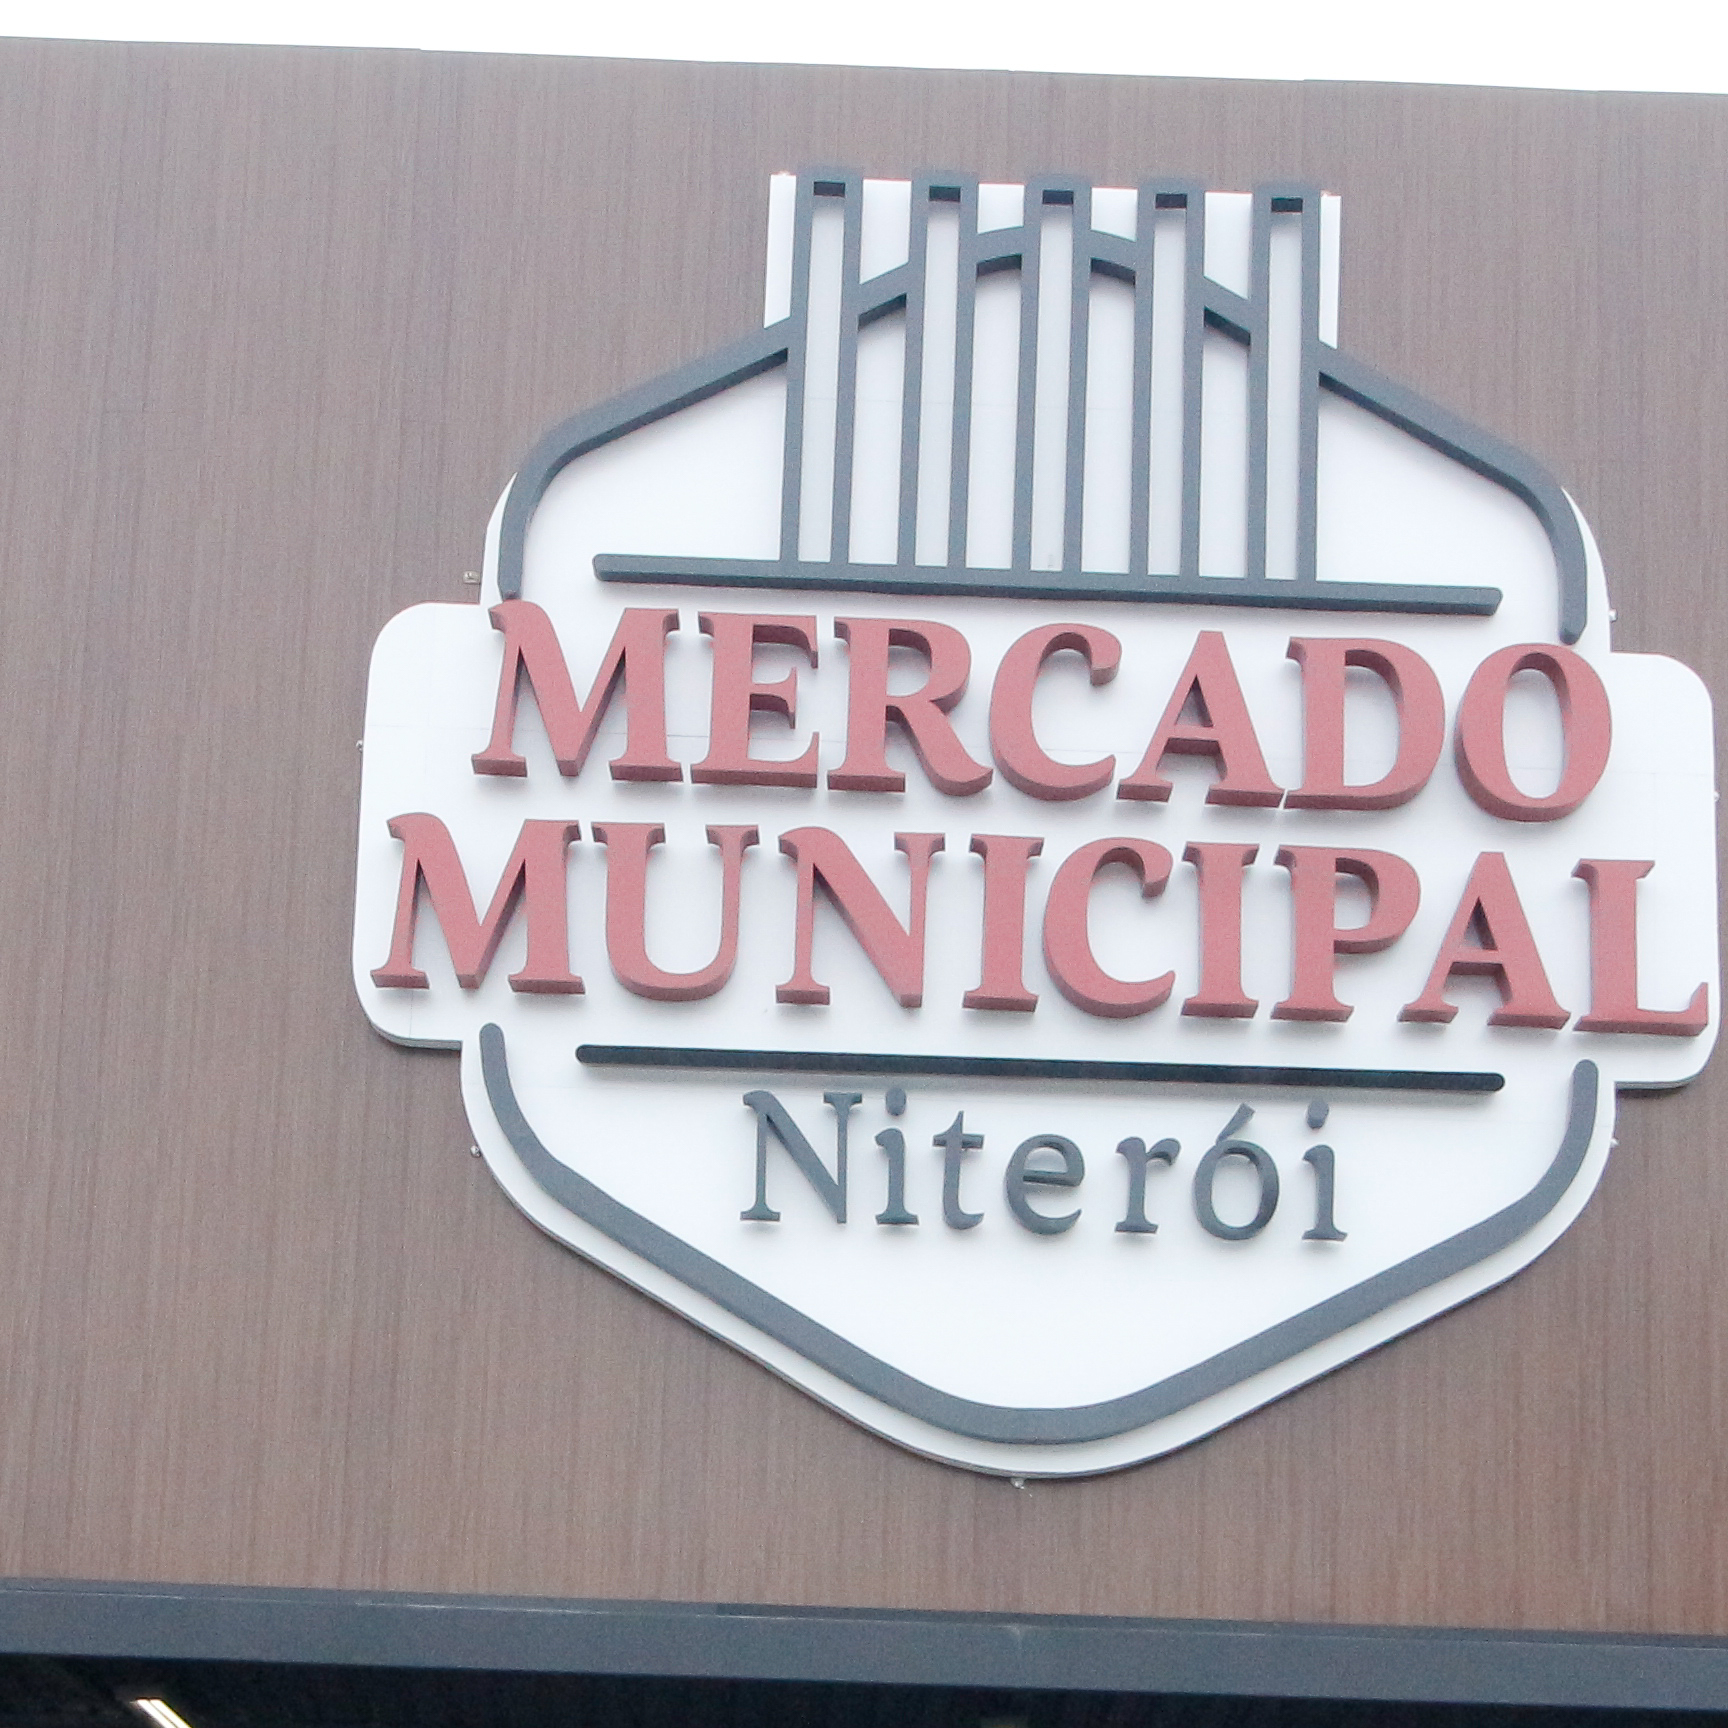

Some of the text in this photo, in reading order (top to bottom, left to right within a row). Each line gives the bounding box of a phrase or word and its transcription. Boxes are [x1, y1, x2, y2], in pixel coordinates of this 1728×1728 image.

[471, 597, 1612, 824] MERCADO
[369, 812, 1710, 1038] MUNICIPAL
[739, 1089, 1349, 1244] Niterói
